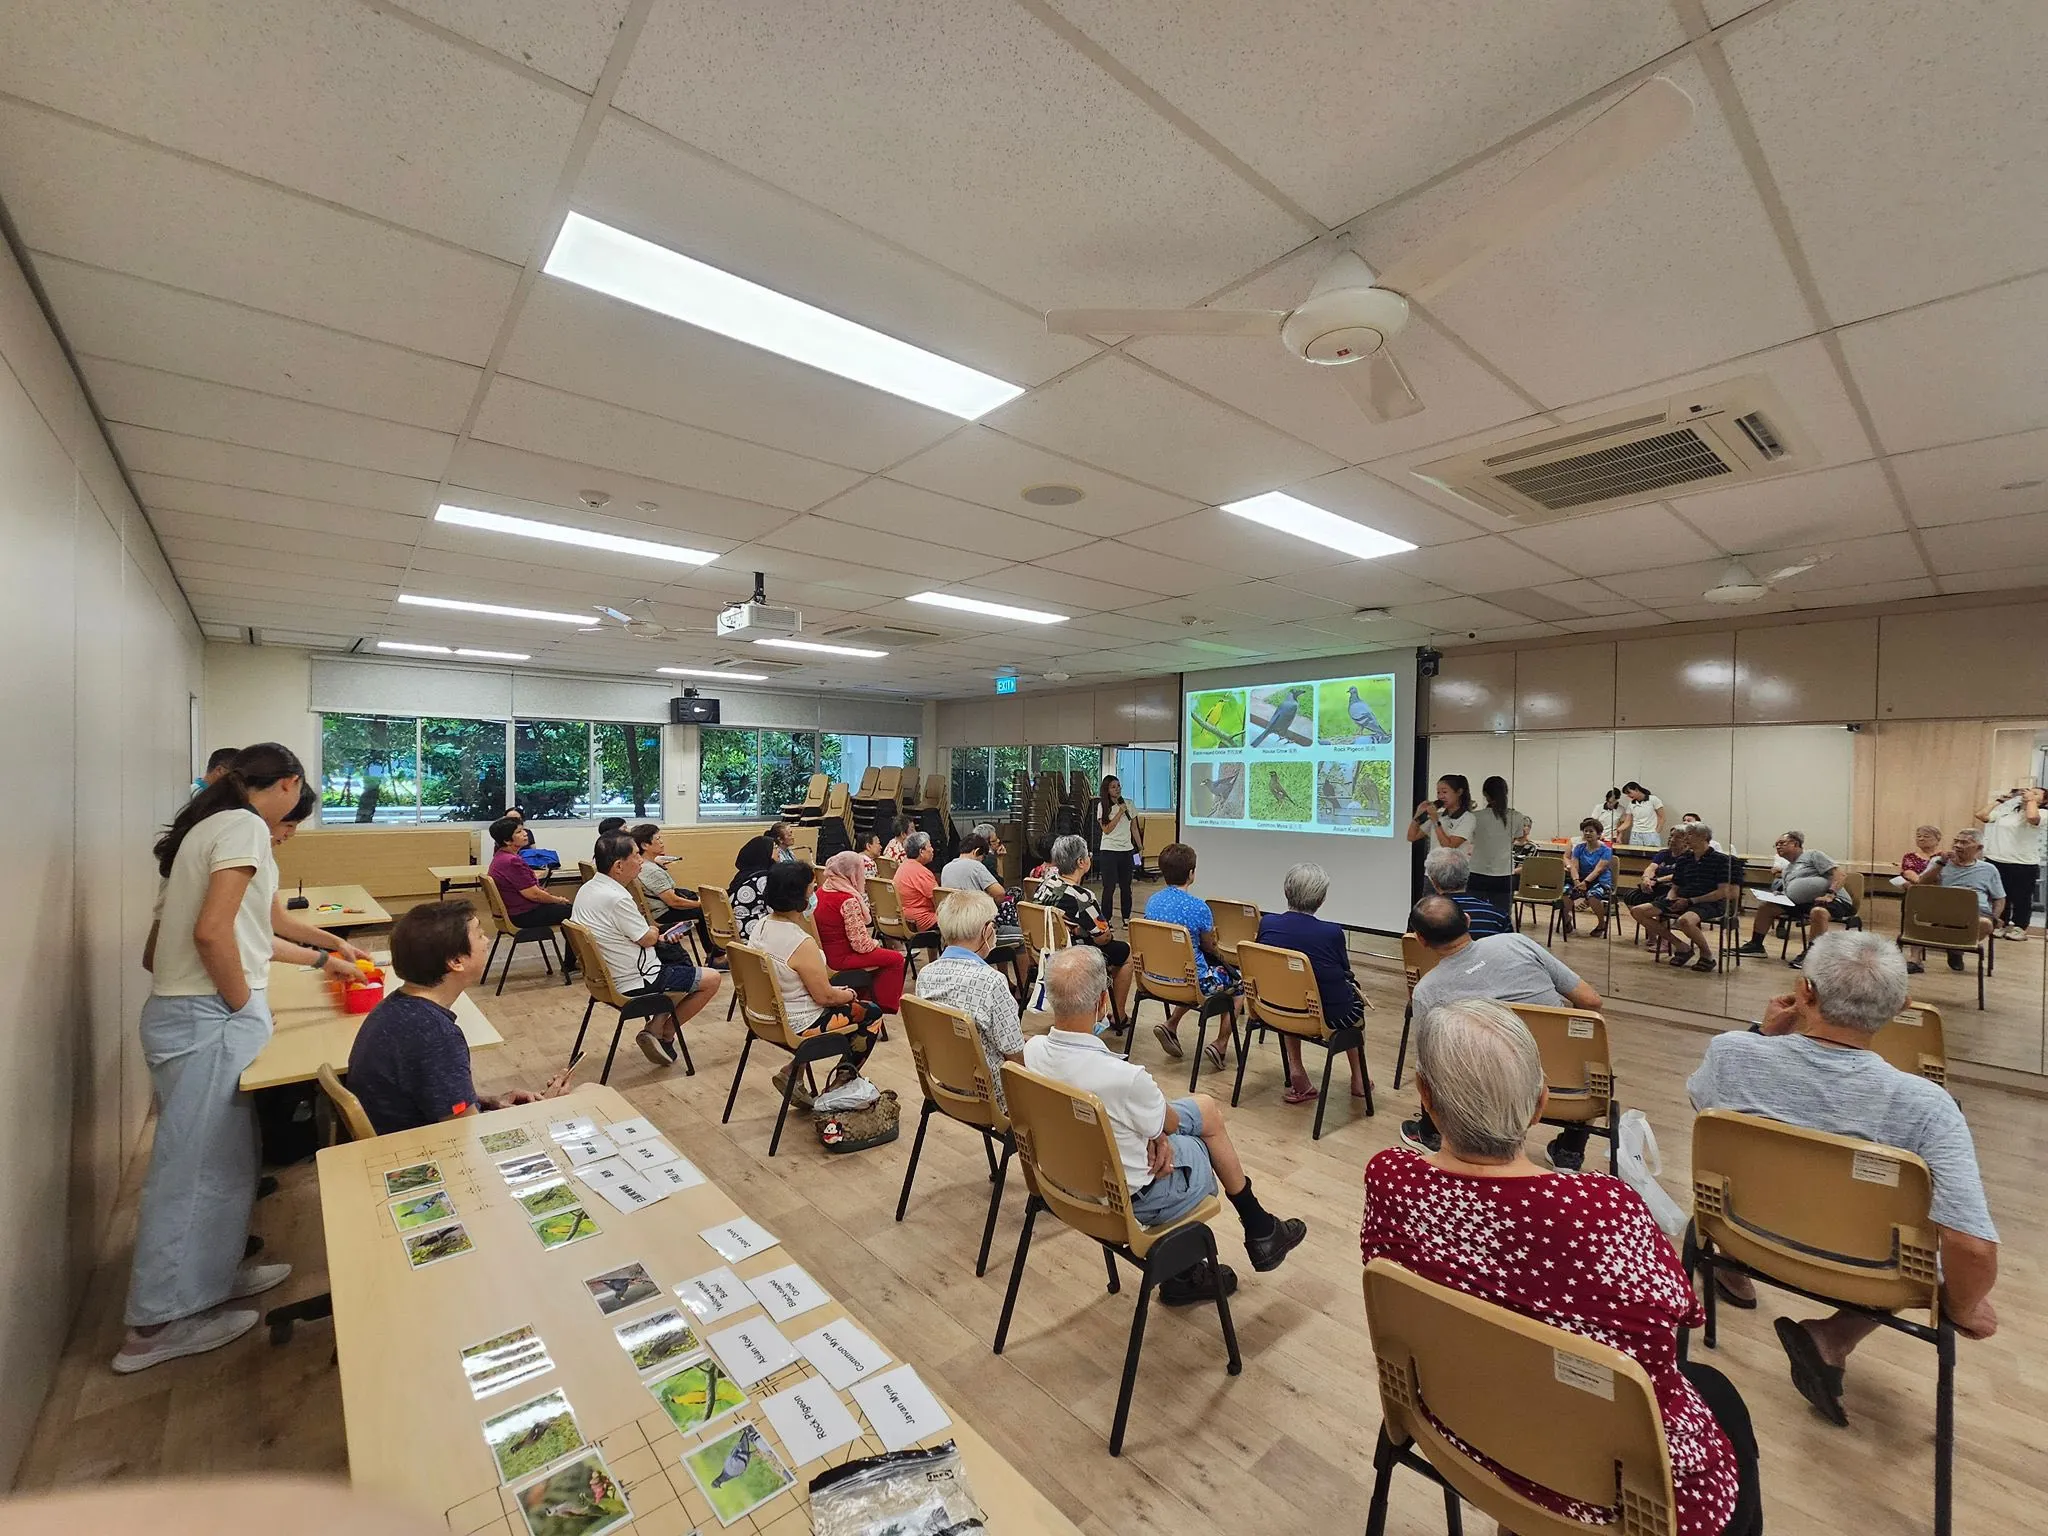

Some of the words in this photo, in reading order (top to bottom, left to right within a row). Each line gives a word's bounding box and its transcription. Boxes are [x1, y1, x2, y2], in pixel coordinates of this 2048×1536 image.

[998, 680, 1010, 692] EXIT
[726, 1228, 739, 1238] Dove
[737, 1236, 751, 1248] Zebra
[694, 1280, 724, 1311] Yellow-vented
[710, 1283, 728, 1299] Bulbul
[768, 1280, 796, 1308] Black-naped
[785, 1282, 800, 1296] Oriole
[739, 1334, 754, 1349] Koel
[822, 1332, 839, 1348] Myna
[750, 1347, 767, 1364] Asian
[837, 1345, 865, 1372] Common
[882, 1384, 900, 1404] Myna
[793, 1395, 813, 1420] Pigeon
[897, 1402, 915, 1425] Javan
[809, 1420, 827, 1440] Rock
